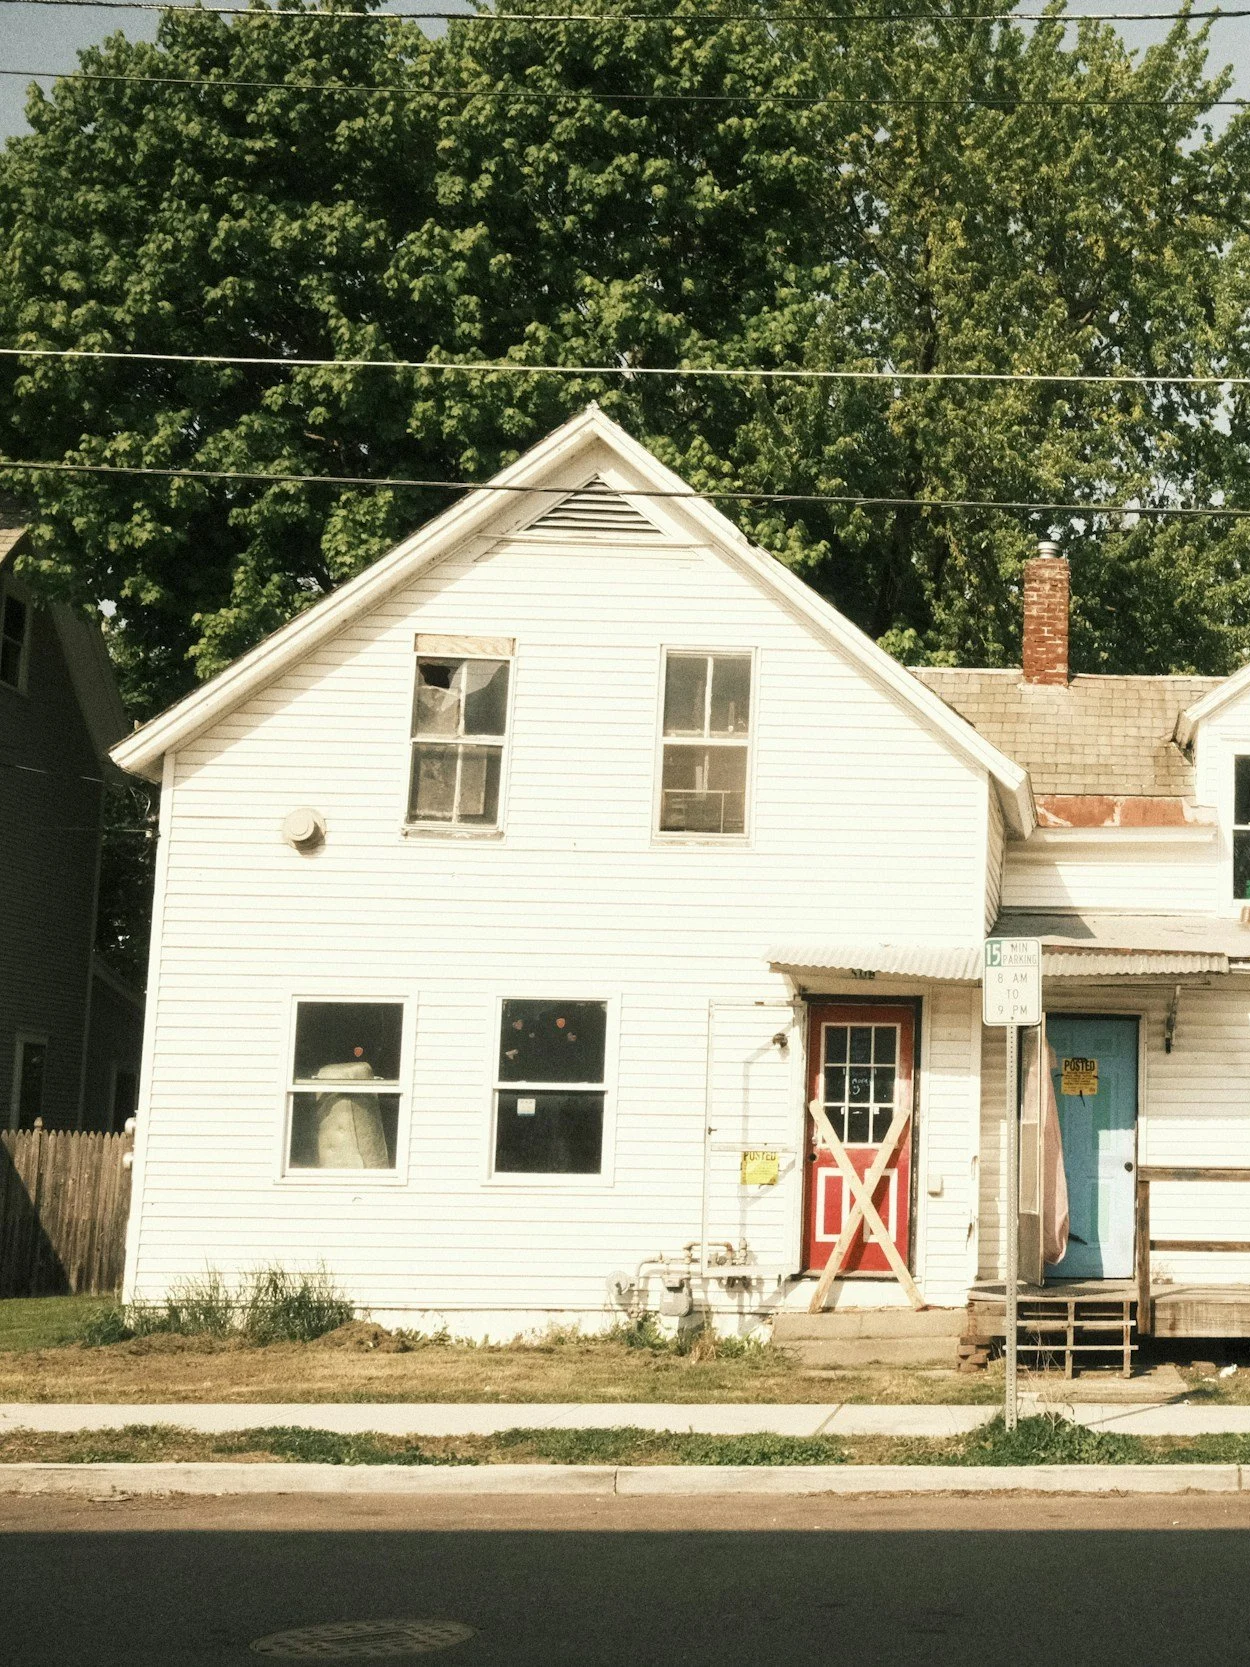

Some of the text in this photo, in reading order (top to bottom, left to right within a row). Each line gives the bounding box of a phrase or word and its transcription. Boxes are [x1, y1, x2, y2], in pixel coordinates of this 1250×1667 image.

[986, 943, 1028, 966] 15 MIN
[1002, 955, 1037, 964] PARKING
[998, 973, 1028, 983] 8 AM
[1007, 989, 1019, 999] TO
[998, 1005, 1028, 1015] 9 PM
[1064, 1060, 1095, 1071] POSTED
